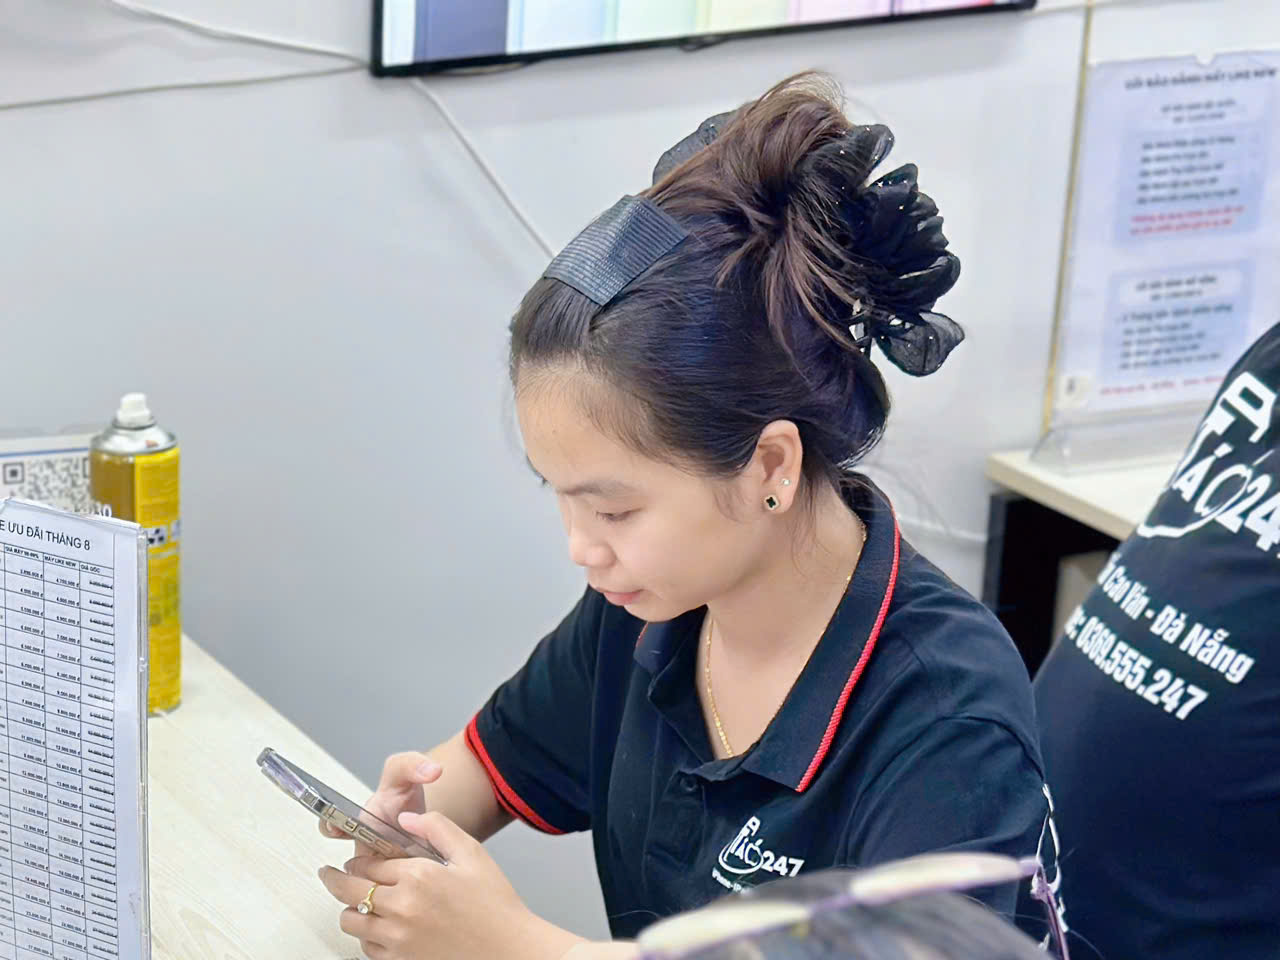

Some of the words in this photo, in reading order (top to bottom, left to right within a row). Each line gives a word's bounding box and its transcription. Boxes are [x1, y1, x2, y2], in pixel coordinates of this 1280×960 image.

[7, 521, 24, 535] ƯU
[26, 525, 44, 540] ĐÃI
[46, 530, 82, 548] THÁNG
[83, 540, 91, 550] 8
[1150, 604, 1189, 645] Đà
[1179, 622, 1256, 685] Nẵng
[761, 850, 805, 878] 247
